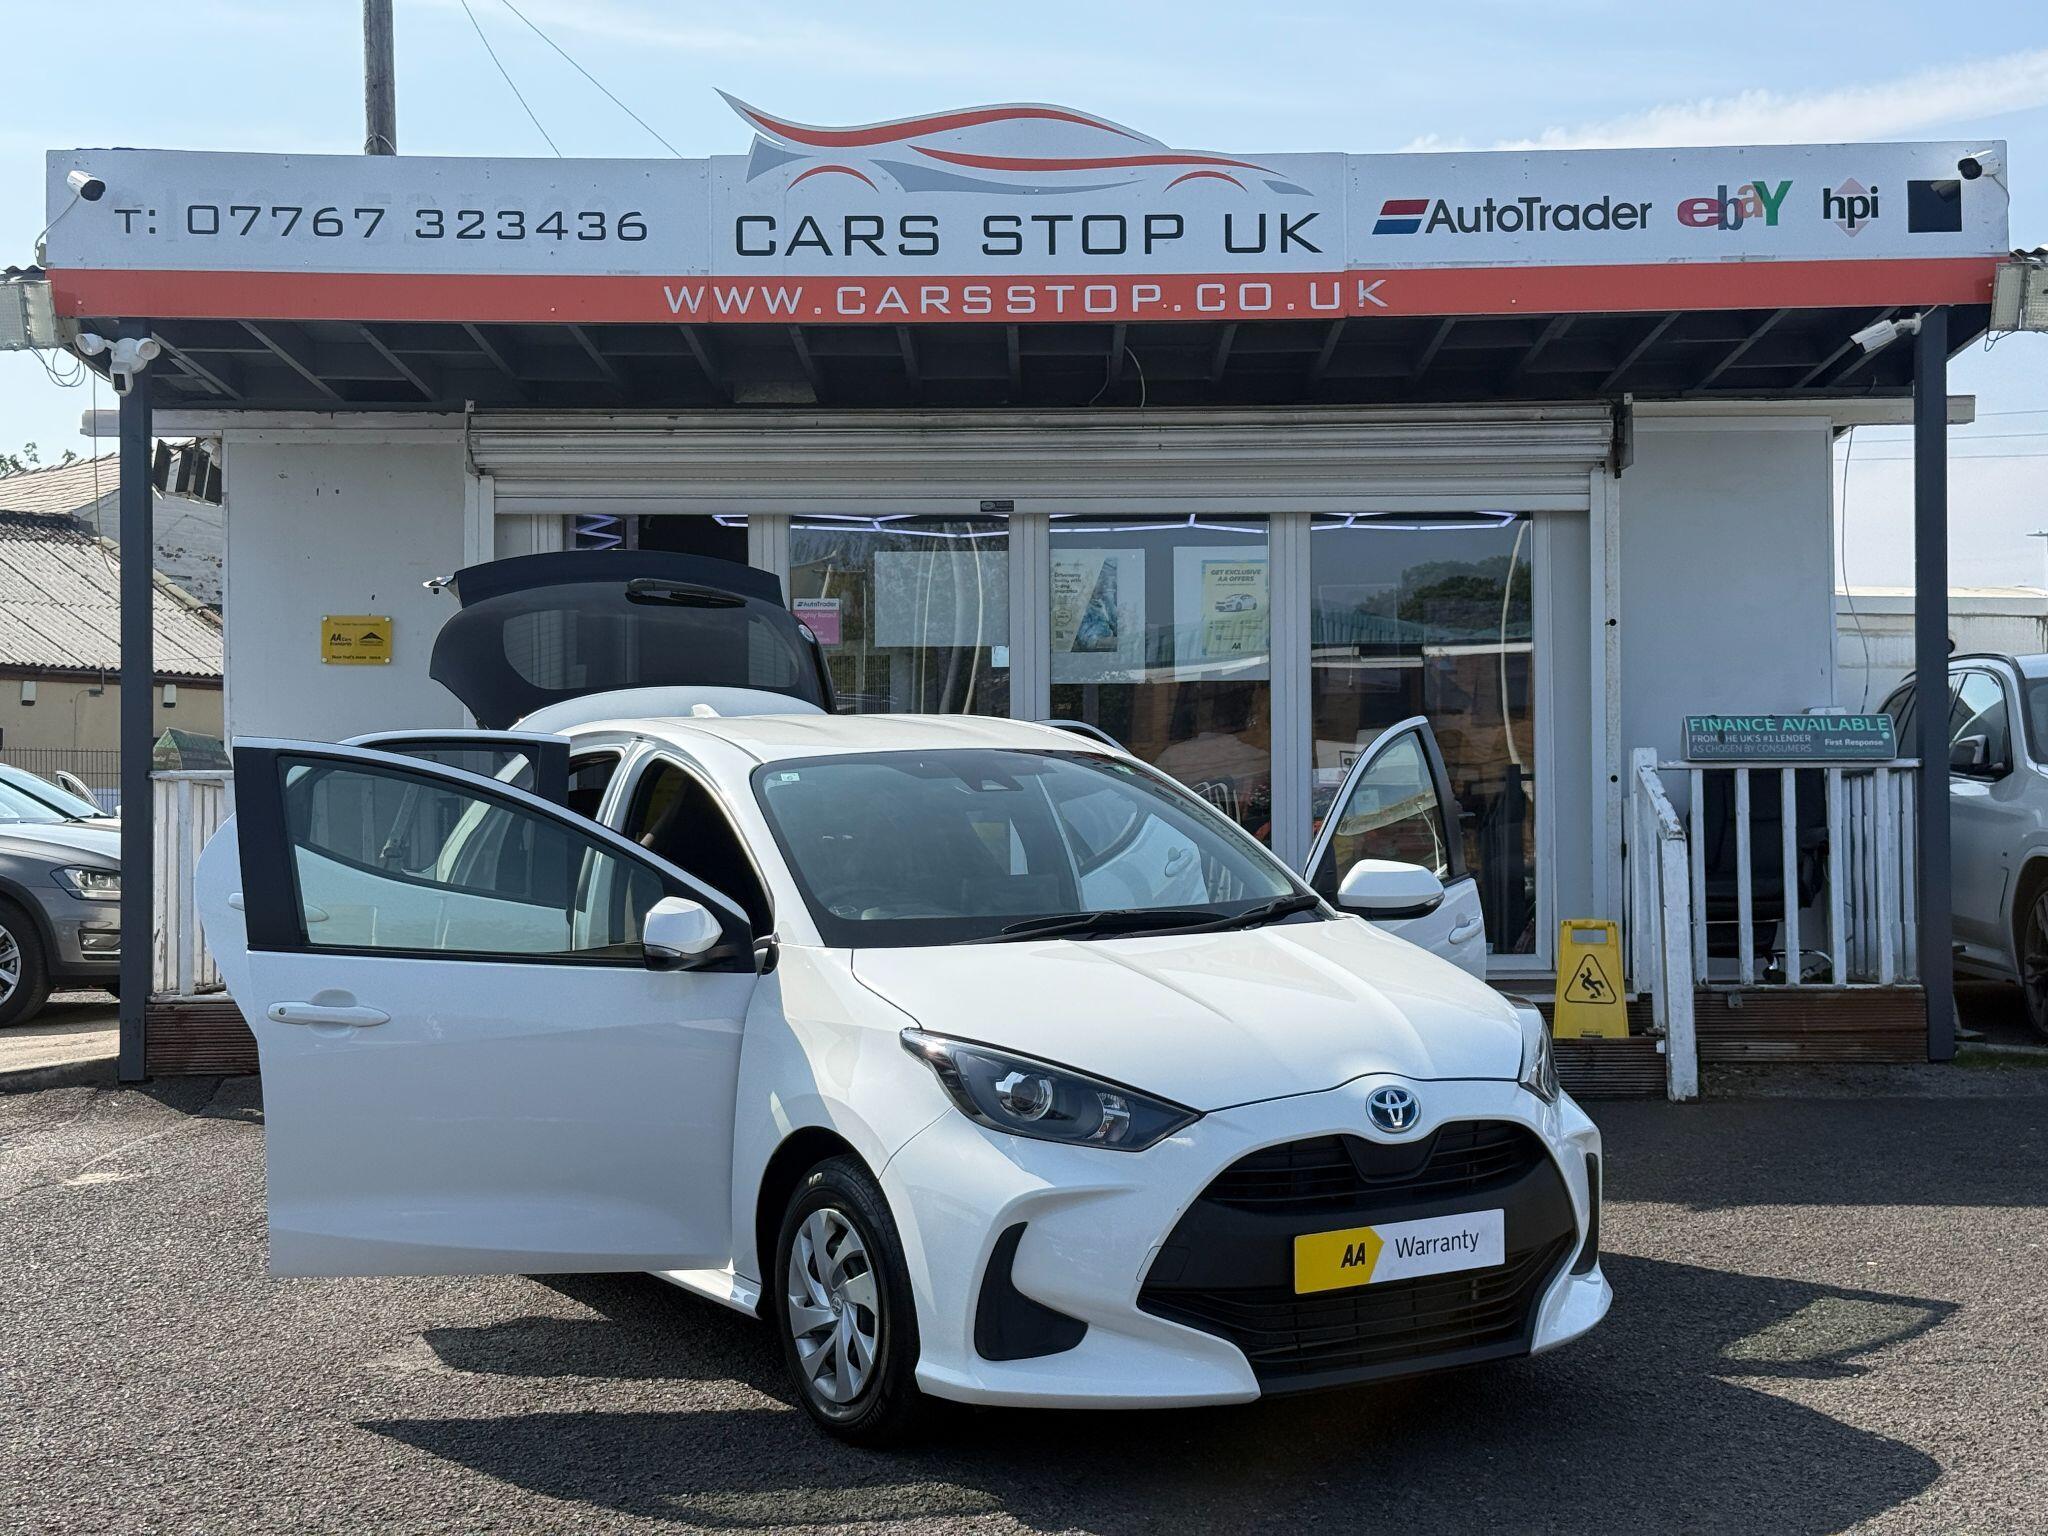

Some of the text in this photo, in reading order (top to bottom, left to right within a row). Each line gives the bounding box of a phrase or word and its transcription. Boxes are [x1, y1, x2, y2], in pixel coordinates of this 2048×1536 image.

[114, 205, 649, 242] T: 07767 323436
[1424, 195, 1652, 233] AutoTrader
[1822, 186, 1879, 236] hpi
[735, 212, 1323, 257] CARS STOP UK
[663, 278, 1388, 316] WWW.CARSSTOP.CO.UK
[1231, 642, 1241, 650] AA
[1689, 717, 1889, 732] FINANCE AVAILABLE
[1692, 734, 1718, 742] FROM
[1721, 734, 1738, 742] HE
[1775, 734, 1811, 742] LENDER
[1824, 738, 1884, 747] First Response
[1705, 745, 1743, 753] CHOSEN
[1757, 745, 1812, 753] CONSUMERS
[1341, 1229, 1480, 1268] AA Warranty
